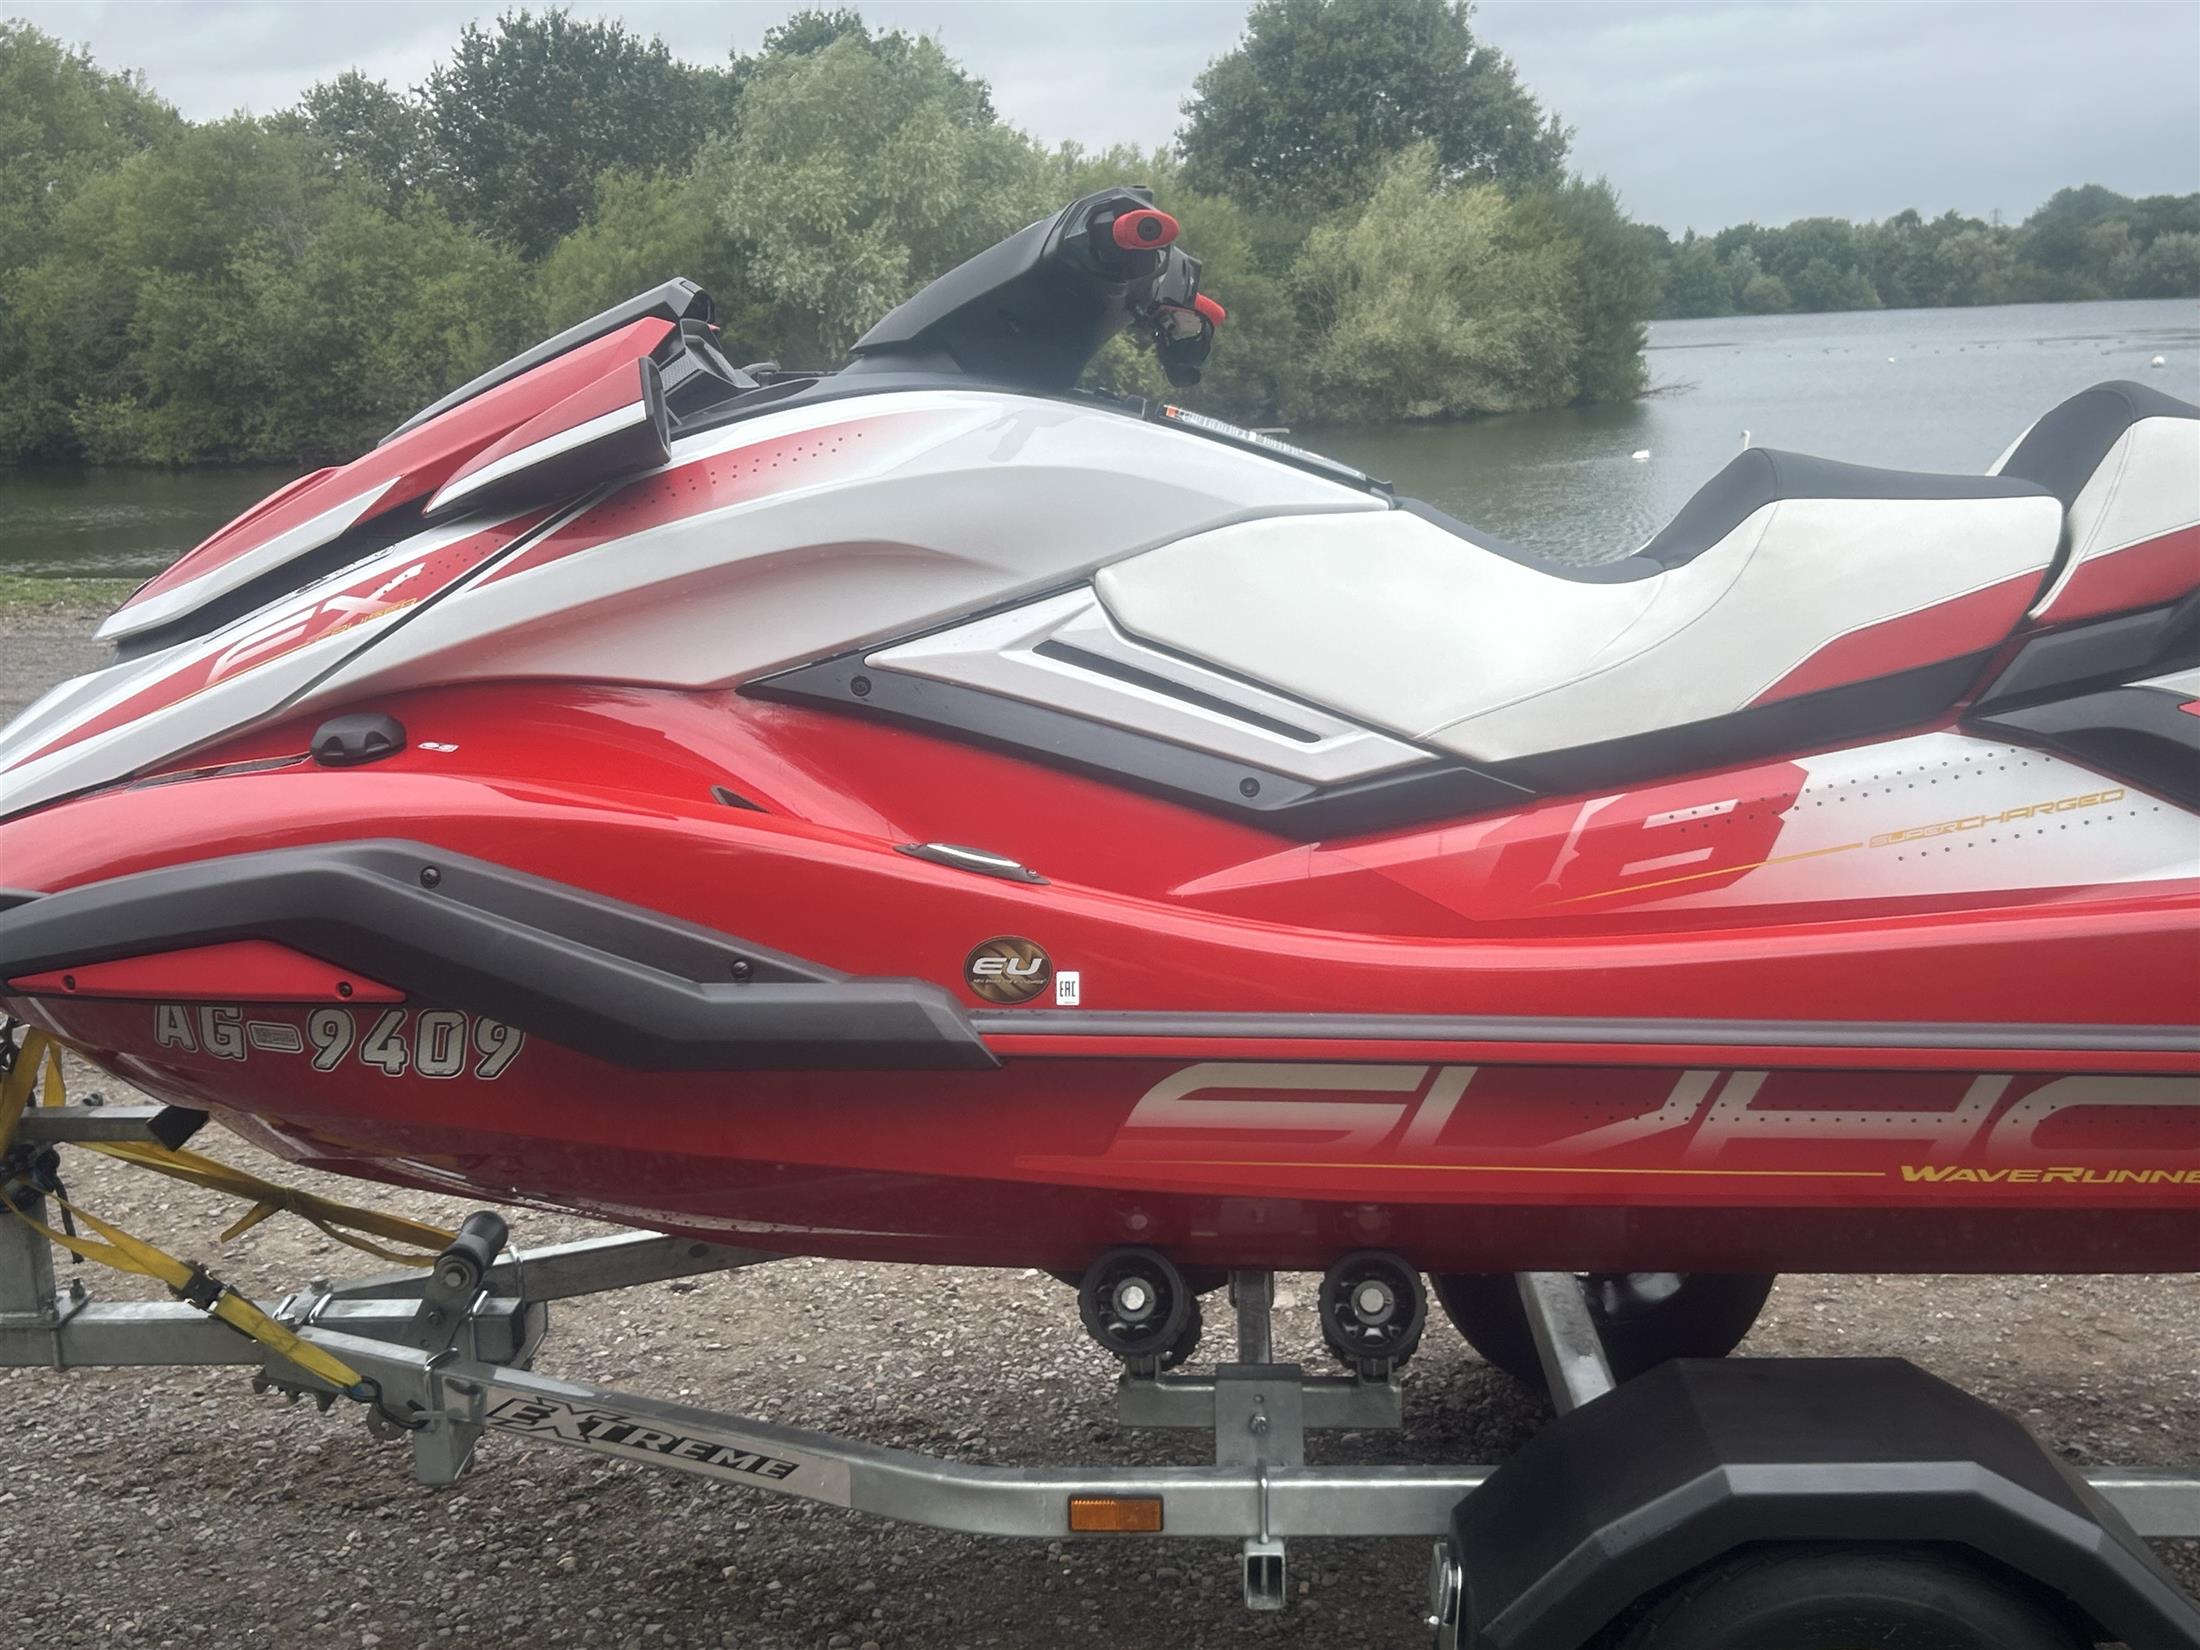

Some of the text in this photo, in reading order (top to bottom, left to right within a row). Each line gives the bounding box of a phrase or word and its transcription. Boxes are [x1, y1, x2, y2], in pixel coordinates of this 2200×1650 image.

[203, 562, 426, 687] FX
[1869, 788, 2126, 848] SUPERCHARGED
[972, 956, 1044, 976] EU
[154, 1003, 526, 1080] AG-9409
[485, 1397, 800, 1480] EXTREME
